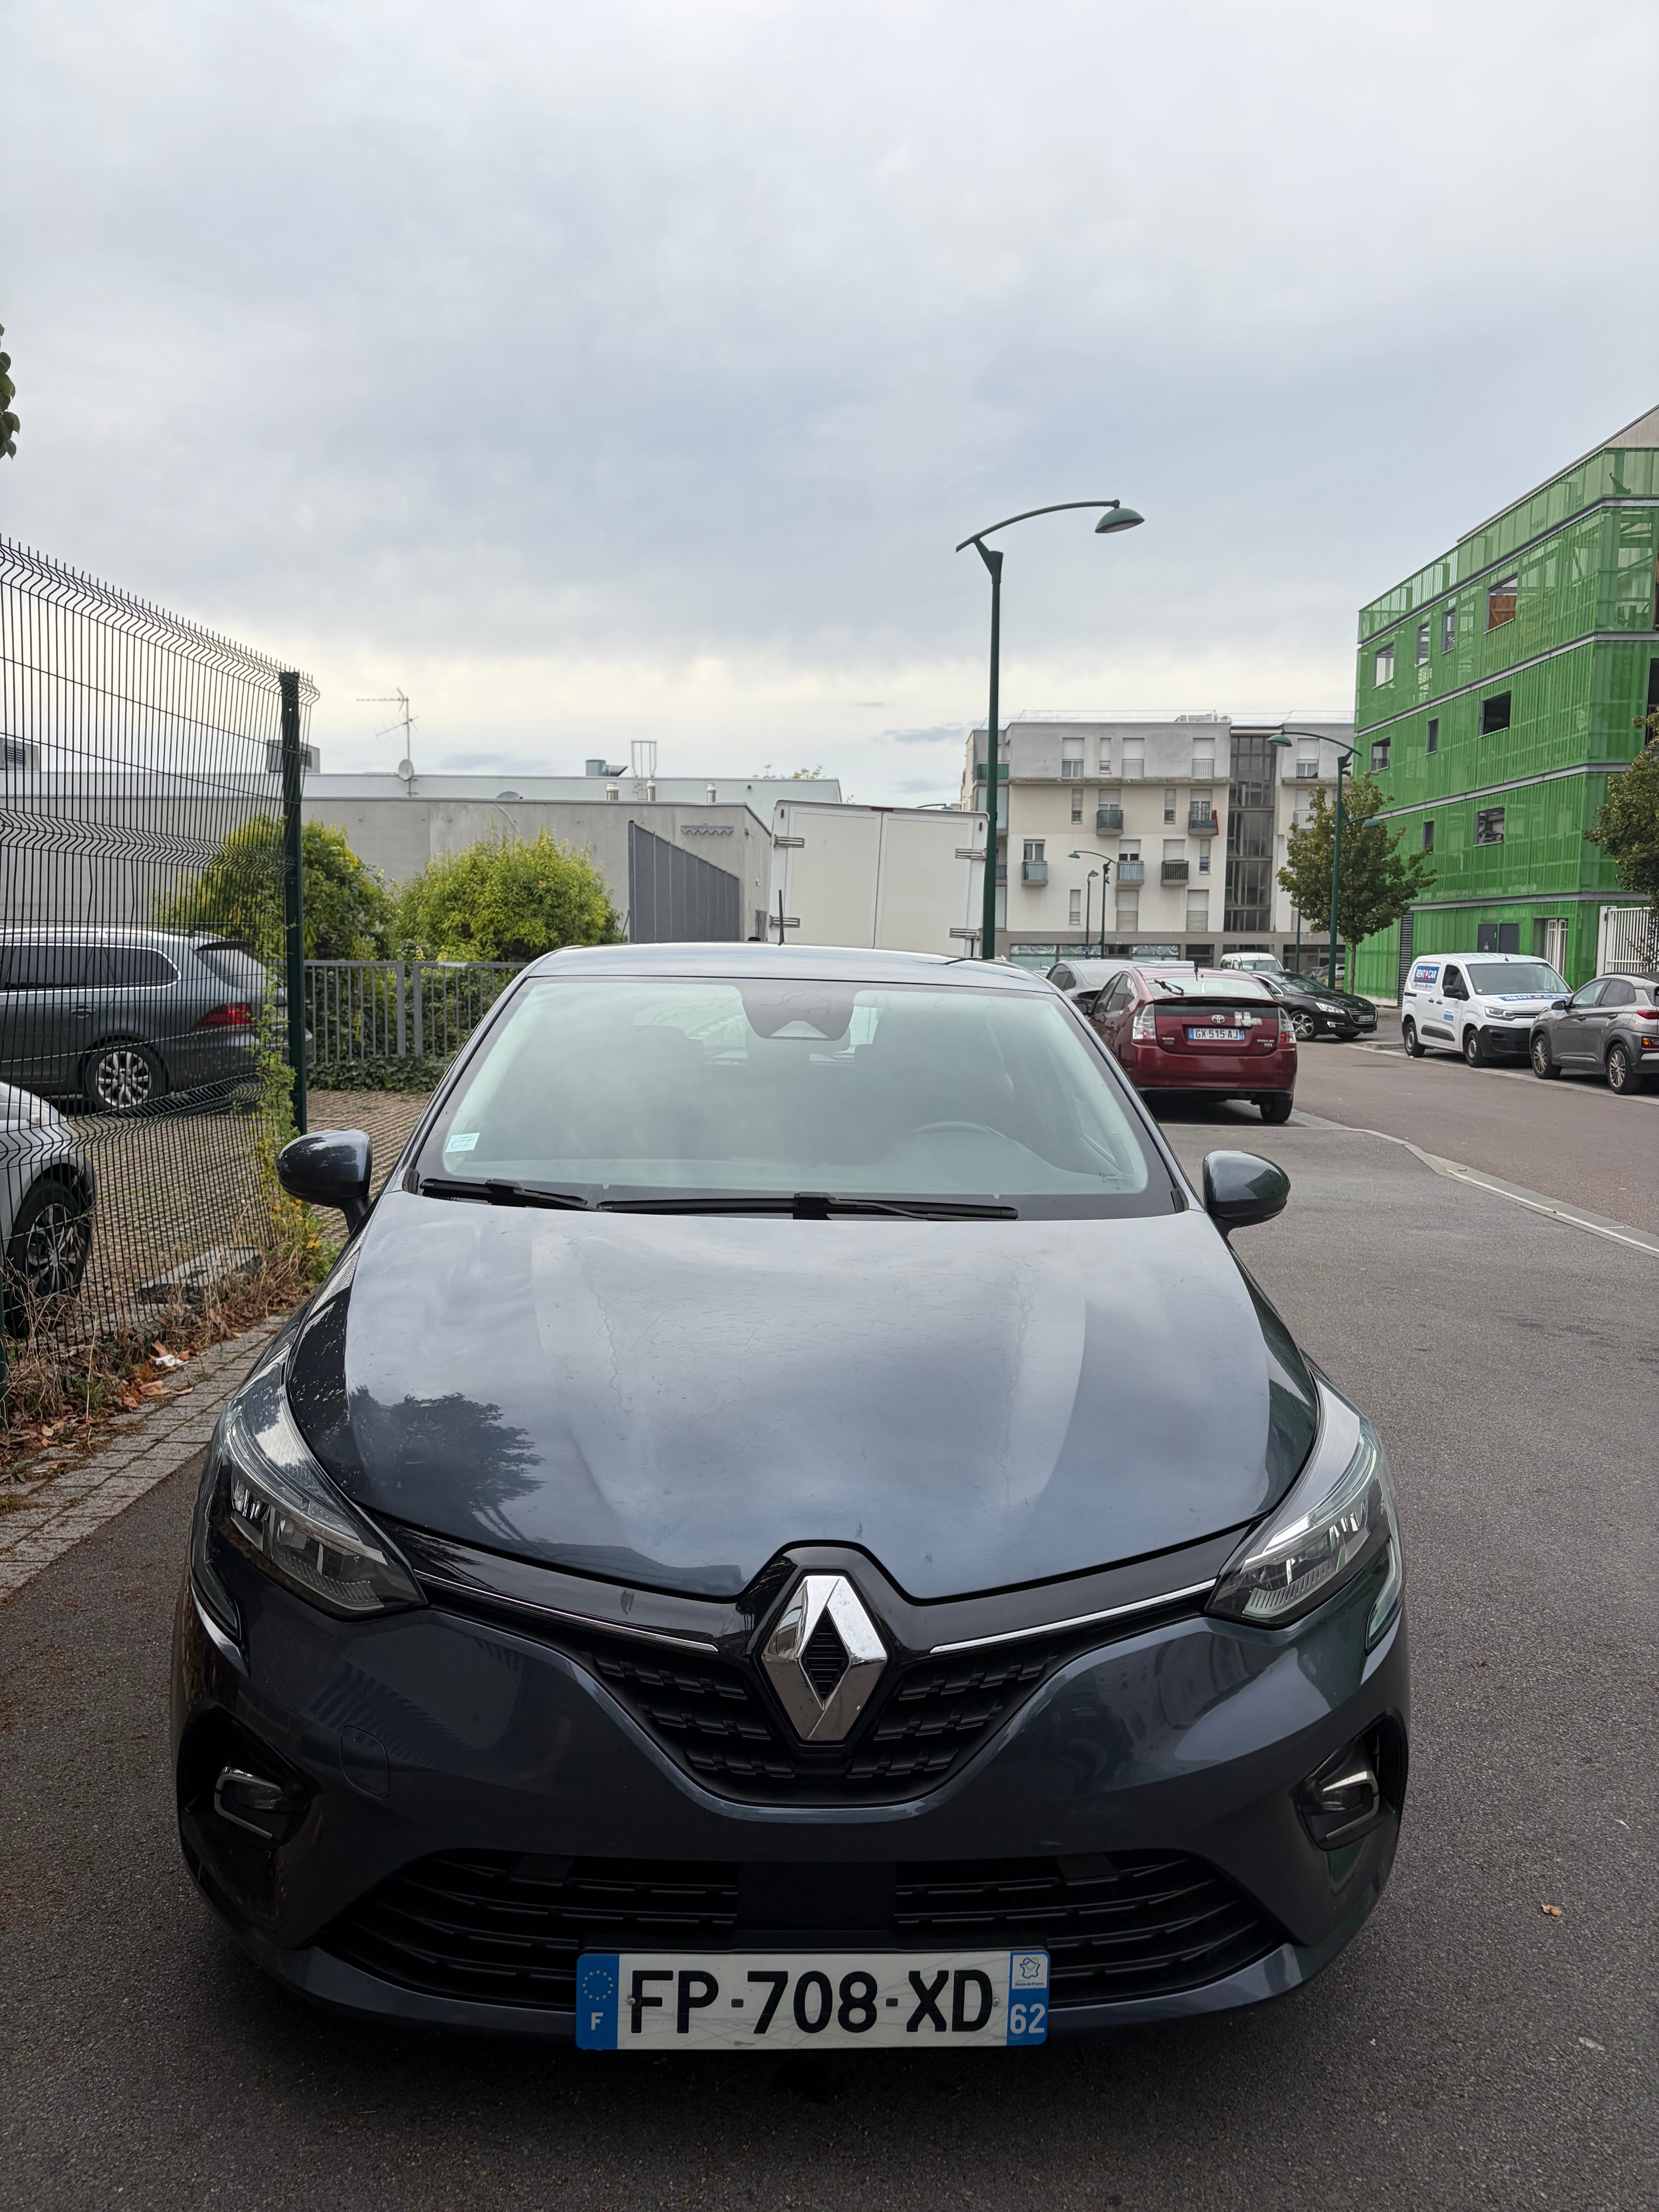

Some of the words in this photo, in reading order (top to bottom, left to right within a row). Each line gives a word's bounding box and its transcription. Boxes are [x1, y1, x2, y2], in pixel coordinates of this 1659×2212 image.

[1416, 969, 1425, 978] RENT
[1428, 970, 1437, 979] CAR
[1195, 1029, 1238, 1039] GX-515-AJ
[631, 1970, 993, 2034] FP-708-XD
[591, 2012, 603, 2030] F
[1010, 2003, 1046, 2034] 62
